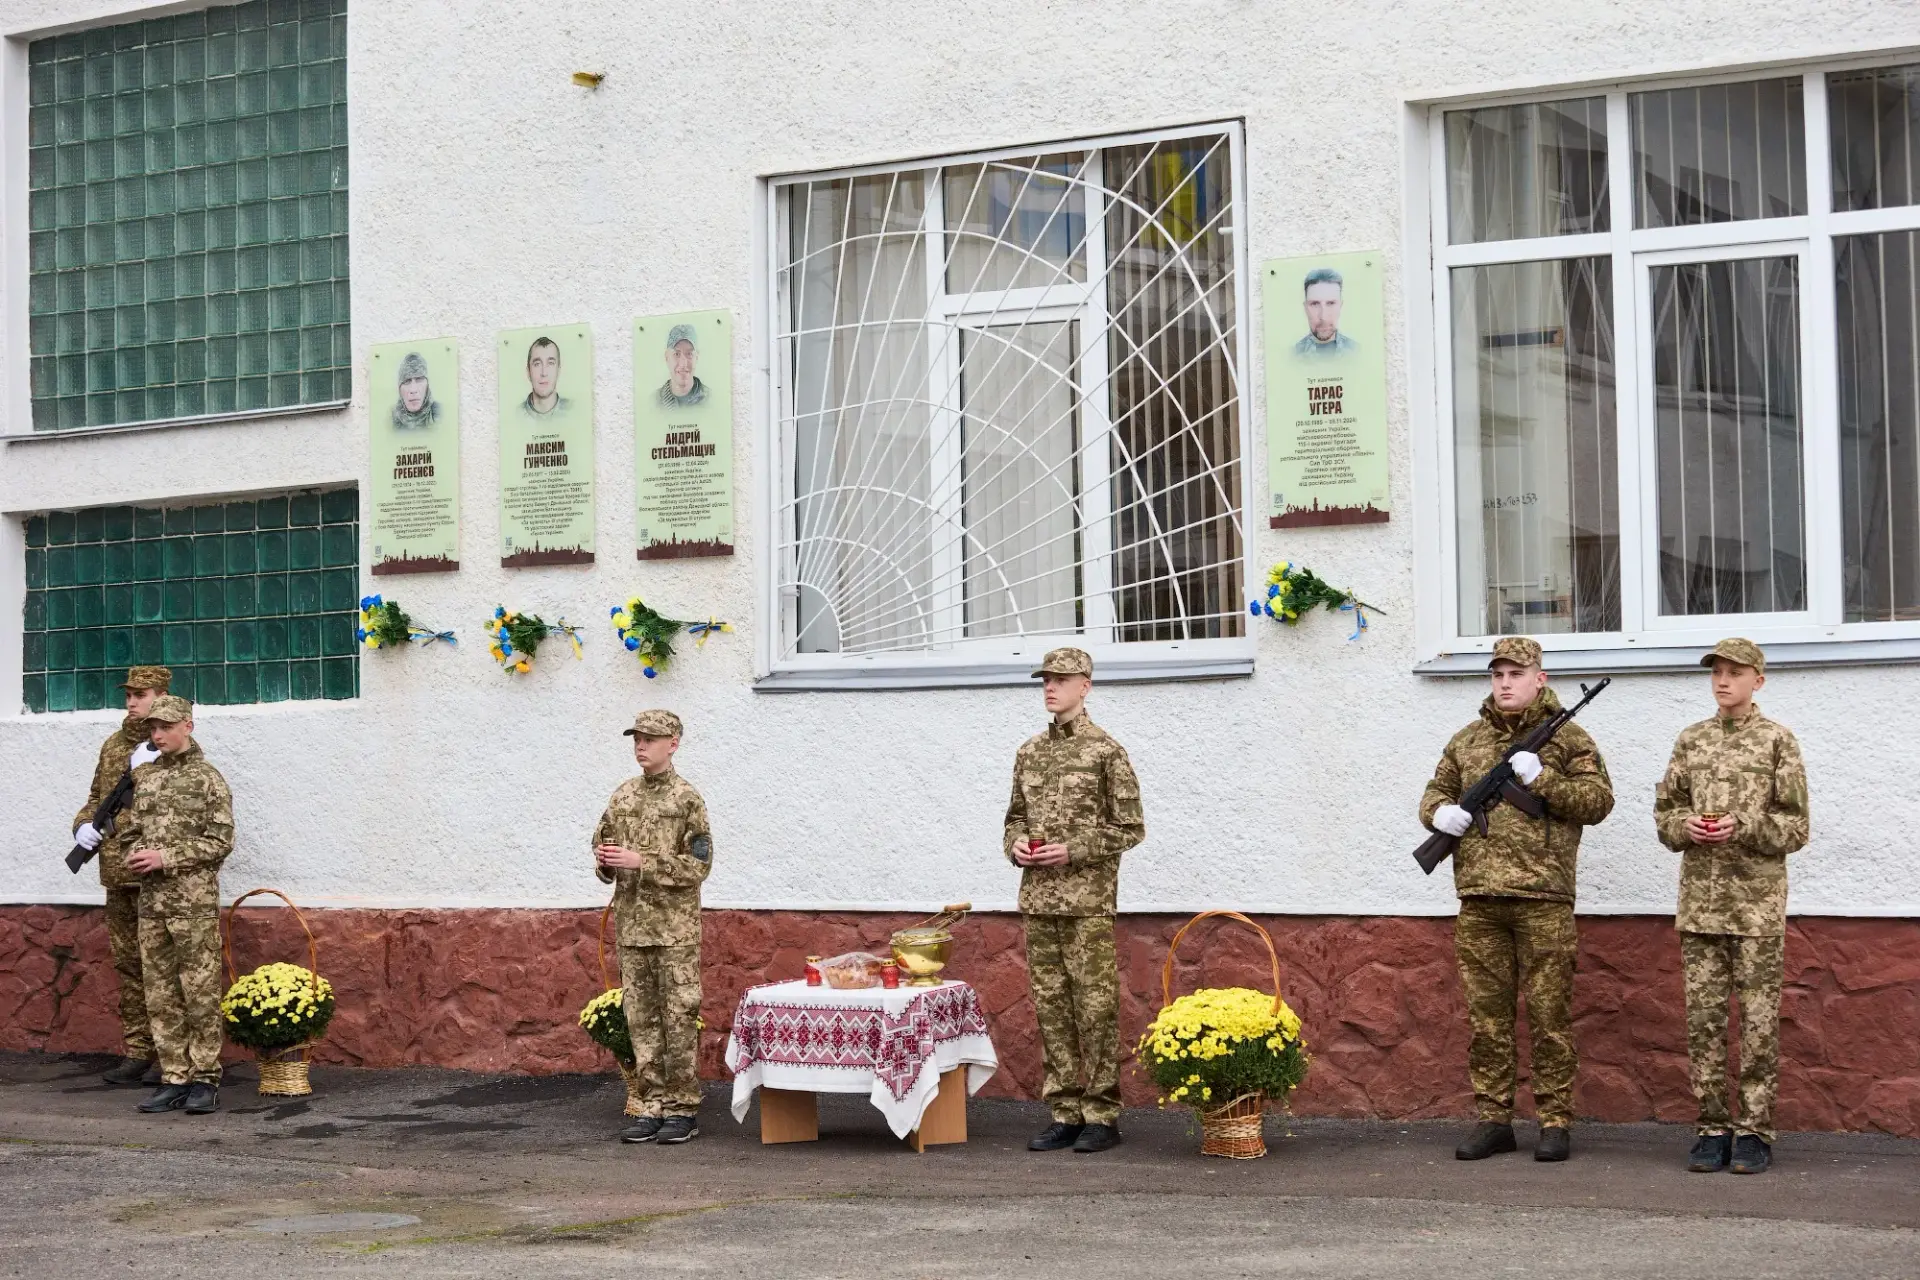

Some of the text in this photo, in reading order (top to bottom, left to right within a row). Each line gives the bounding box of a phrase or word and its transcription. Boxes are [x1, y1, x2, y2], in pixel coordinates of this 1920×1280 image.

[1307, 385, 1343, 400] ТАРАС
[1310, 401, 1342, 415] УГЕРА
[666, 429, 700, 446] АНДРІЙ
[526, 441, 565, 455] МАКСИМ
[651, 444, 716, 460] СТЕЛЬМАЩУК
[396, 450, 432, 466] ЗАХАРІЙ
[524, 454, 568, 469] ГУНЧЕНКО
[393, 465, 434, 479] ГРЕБЕНЄВ
